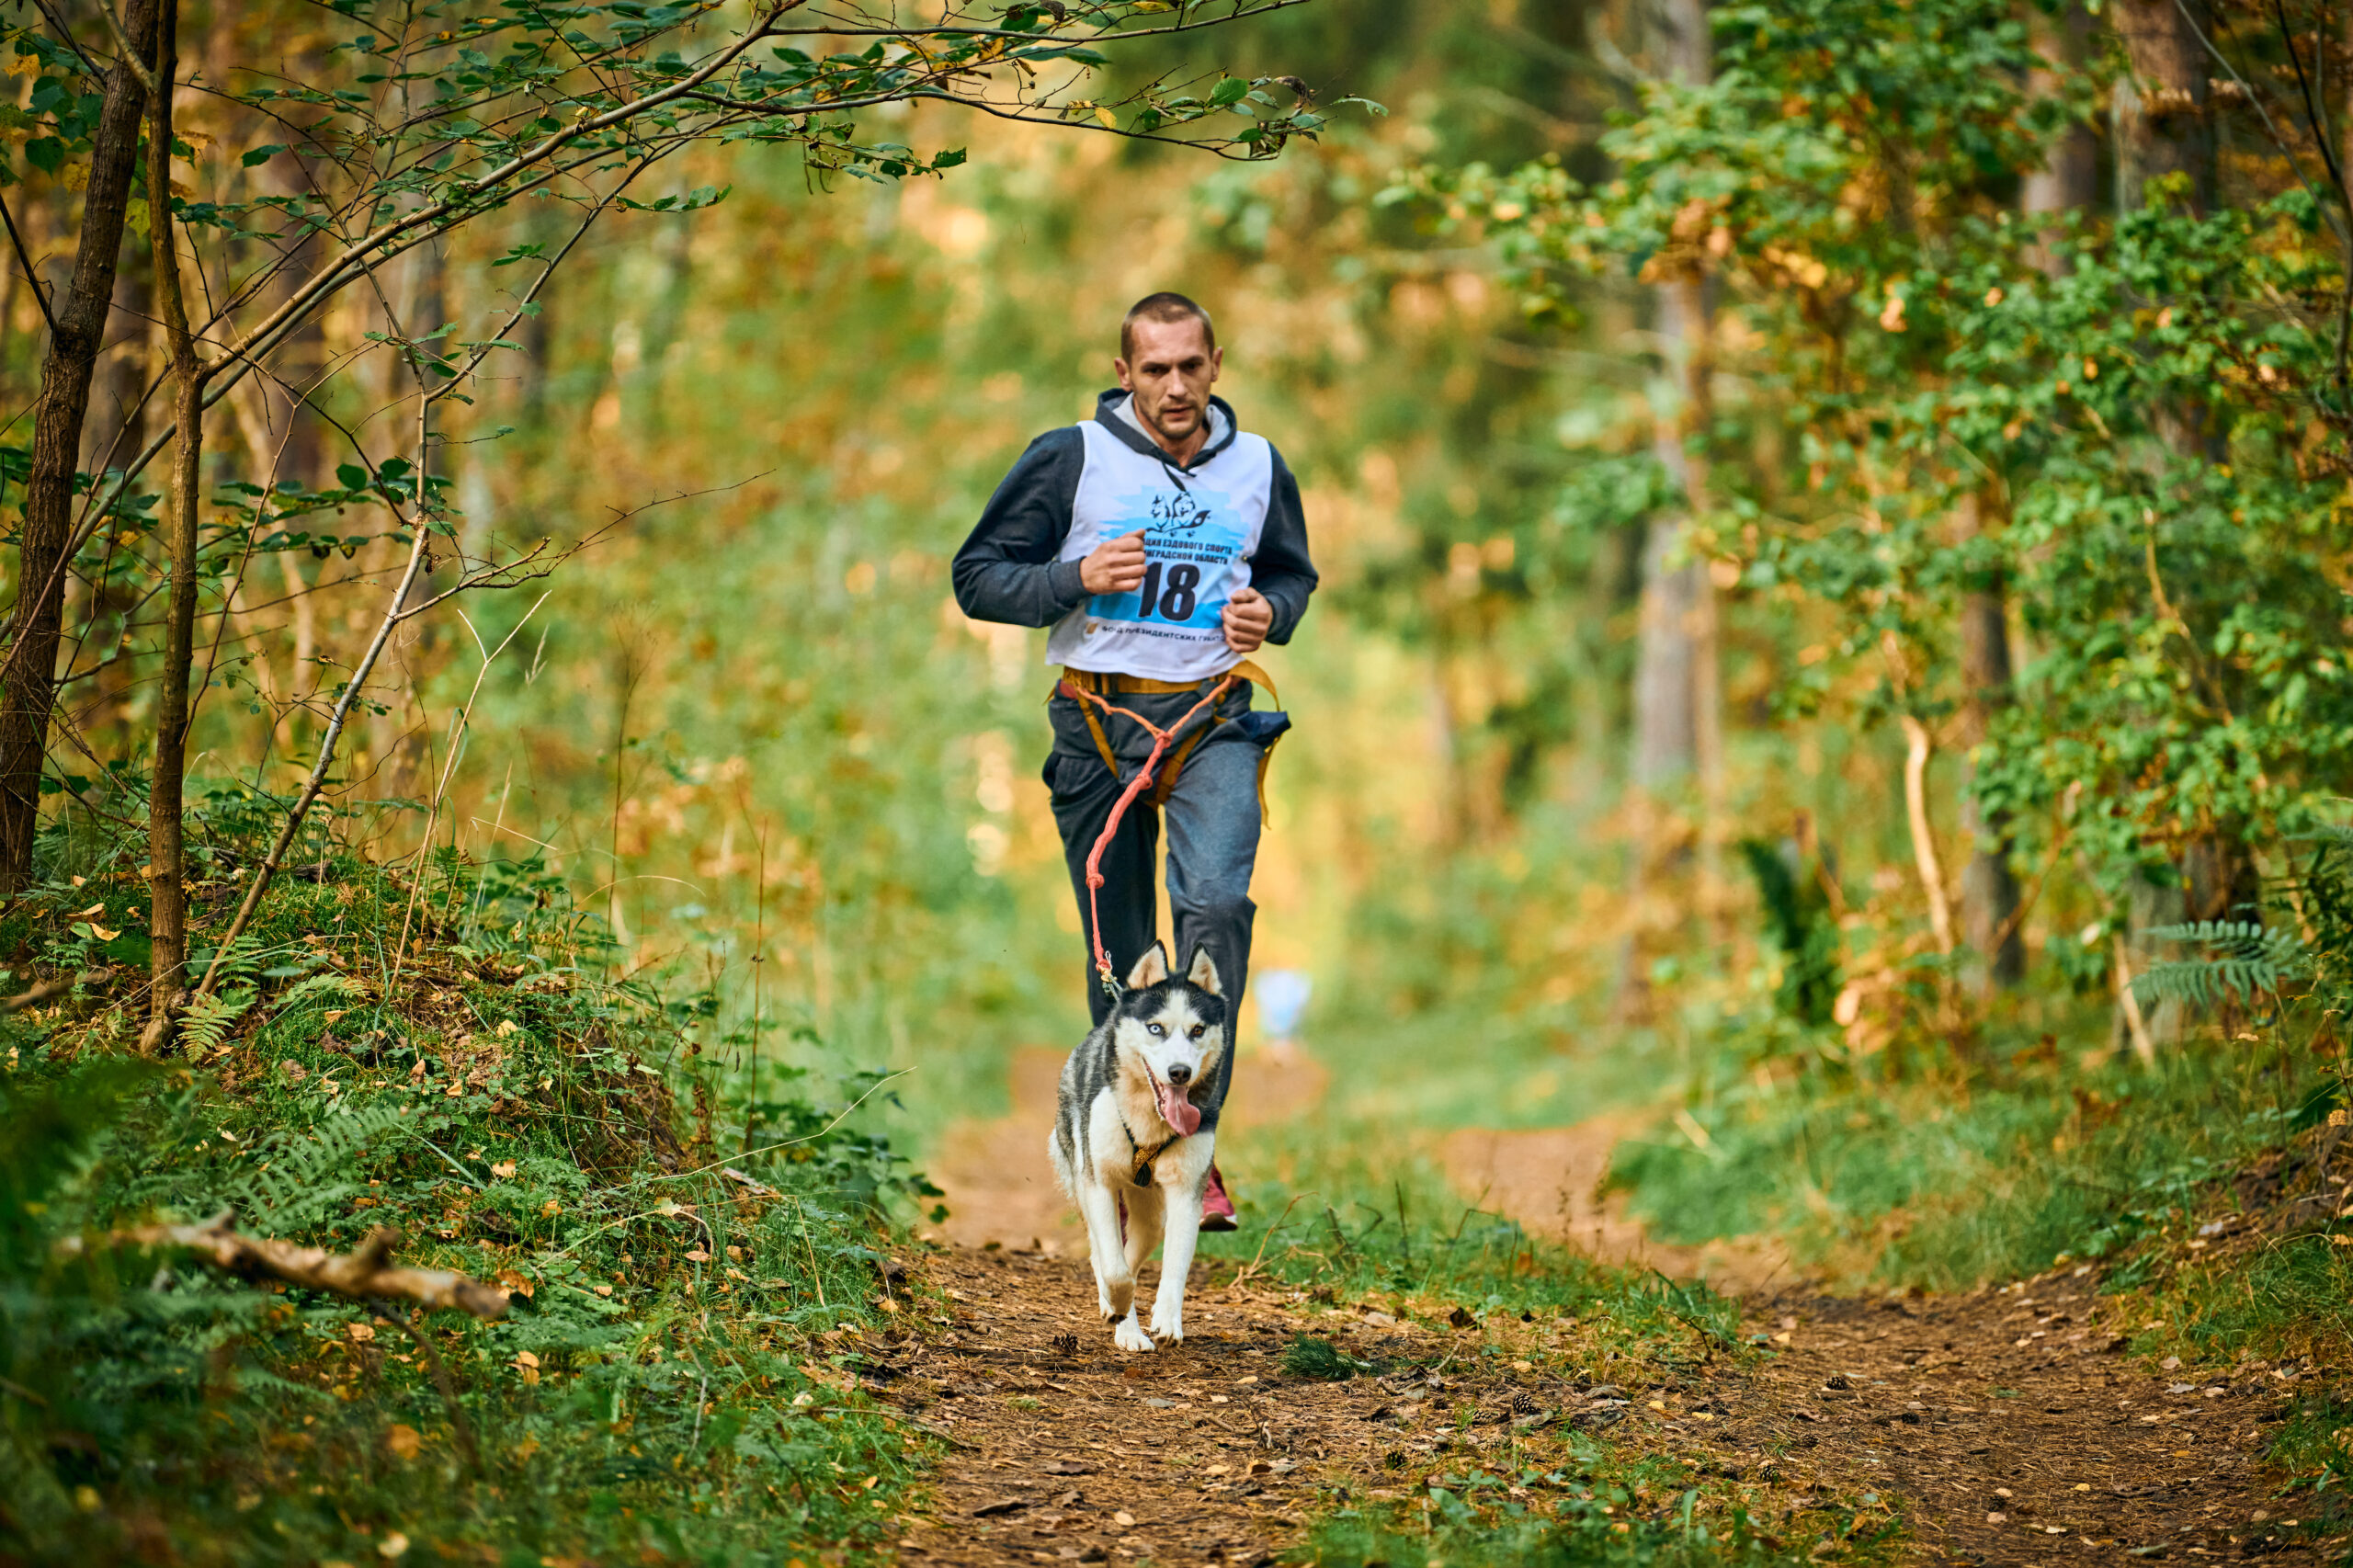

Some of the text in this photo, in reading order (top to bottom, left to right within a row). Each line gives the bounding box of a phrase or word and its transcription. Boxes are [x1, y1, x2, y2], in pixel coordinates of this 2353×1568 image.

[1163, 539, 1203, 551] ЕЗДОВОГО
[1205, 543, 1233, 554] СПОРТА
[1144, 550, 1228, 565] НГРАДСКОЙ ОБЛАСТИ
[1138, 562, 1200, 621] 18
